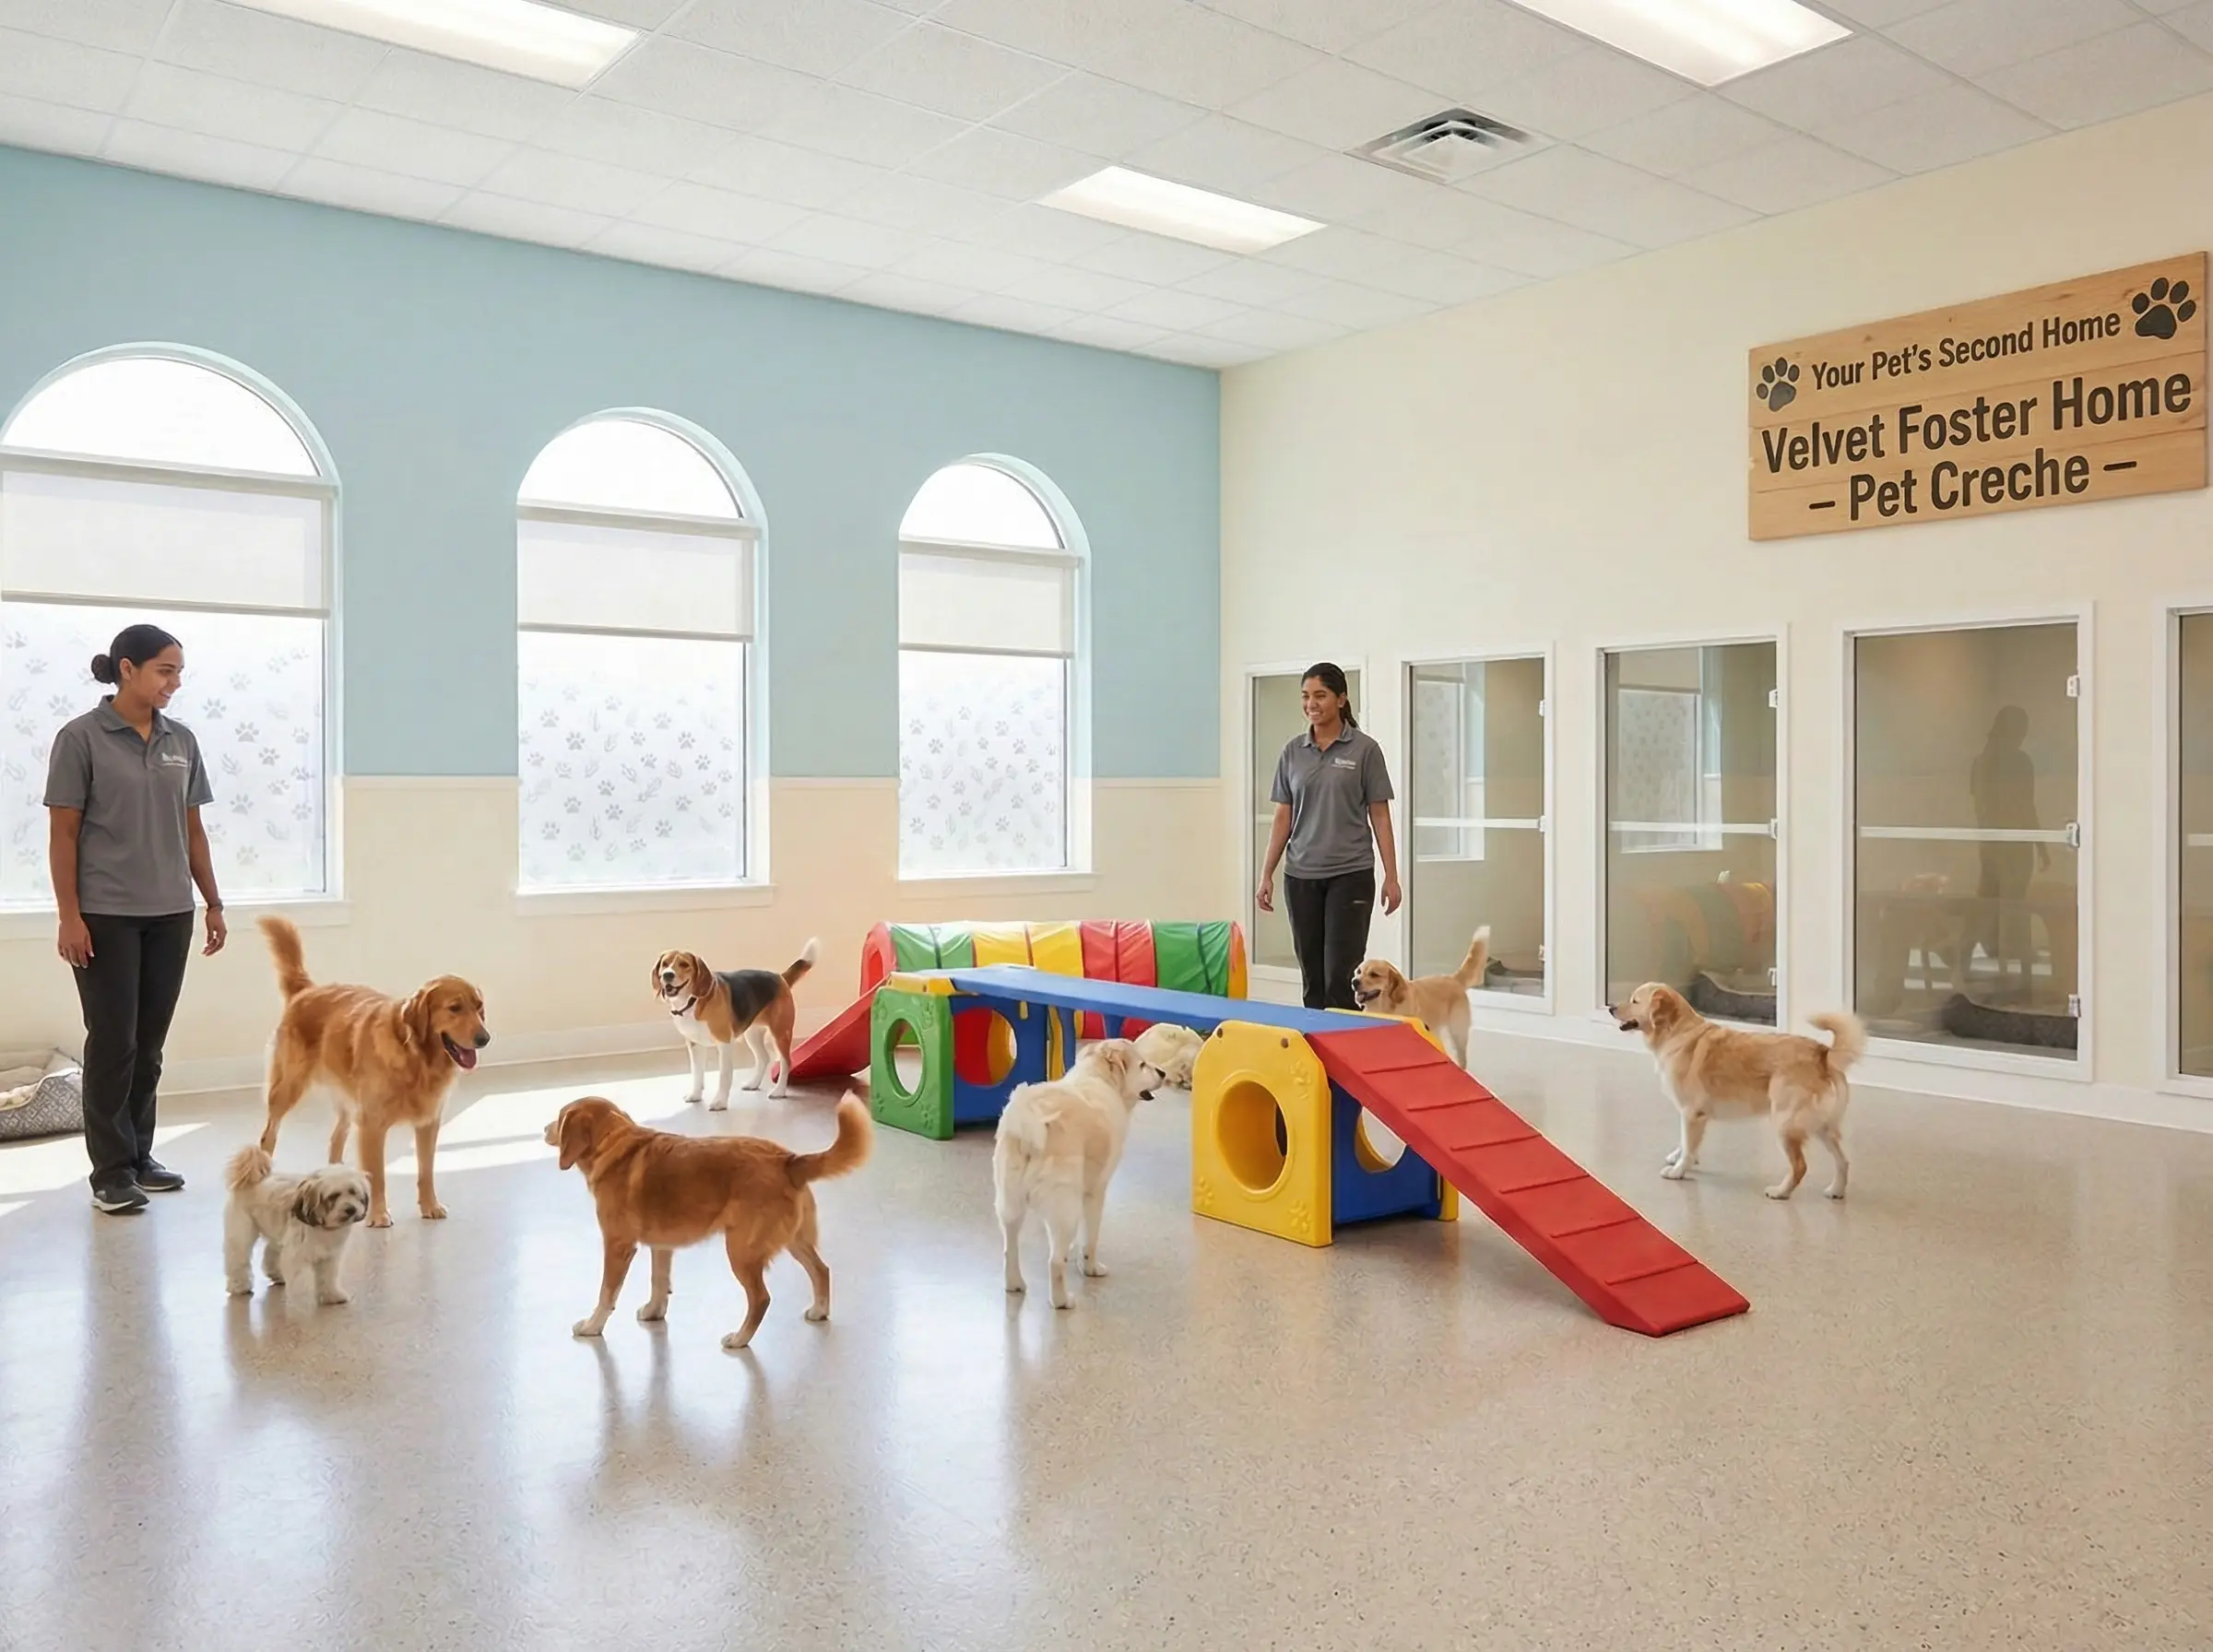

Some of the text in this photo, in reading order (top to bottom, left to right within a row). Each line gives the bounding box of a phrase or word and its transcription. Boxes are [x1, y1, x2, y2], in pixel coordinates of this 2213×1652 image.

[1811, 313, 2121, 390] Your Pet’s Second Home
[1762, 372, 2192, 473] Velvet Foster Home
[1850, 469, 1918, 521] Pet
[1931, 447, 2089, 511] Creche
